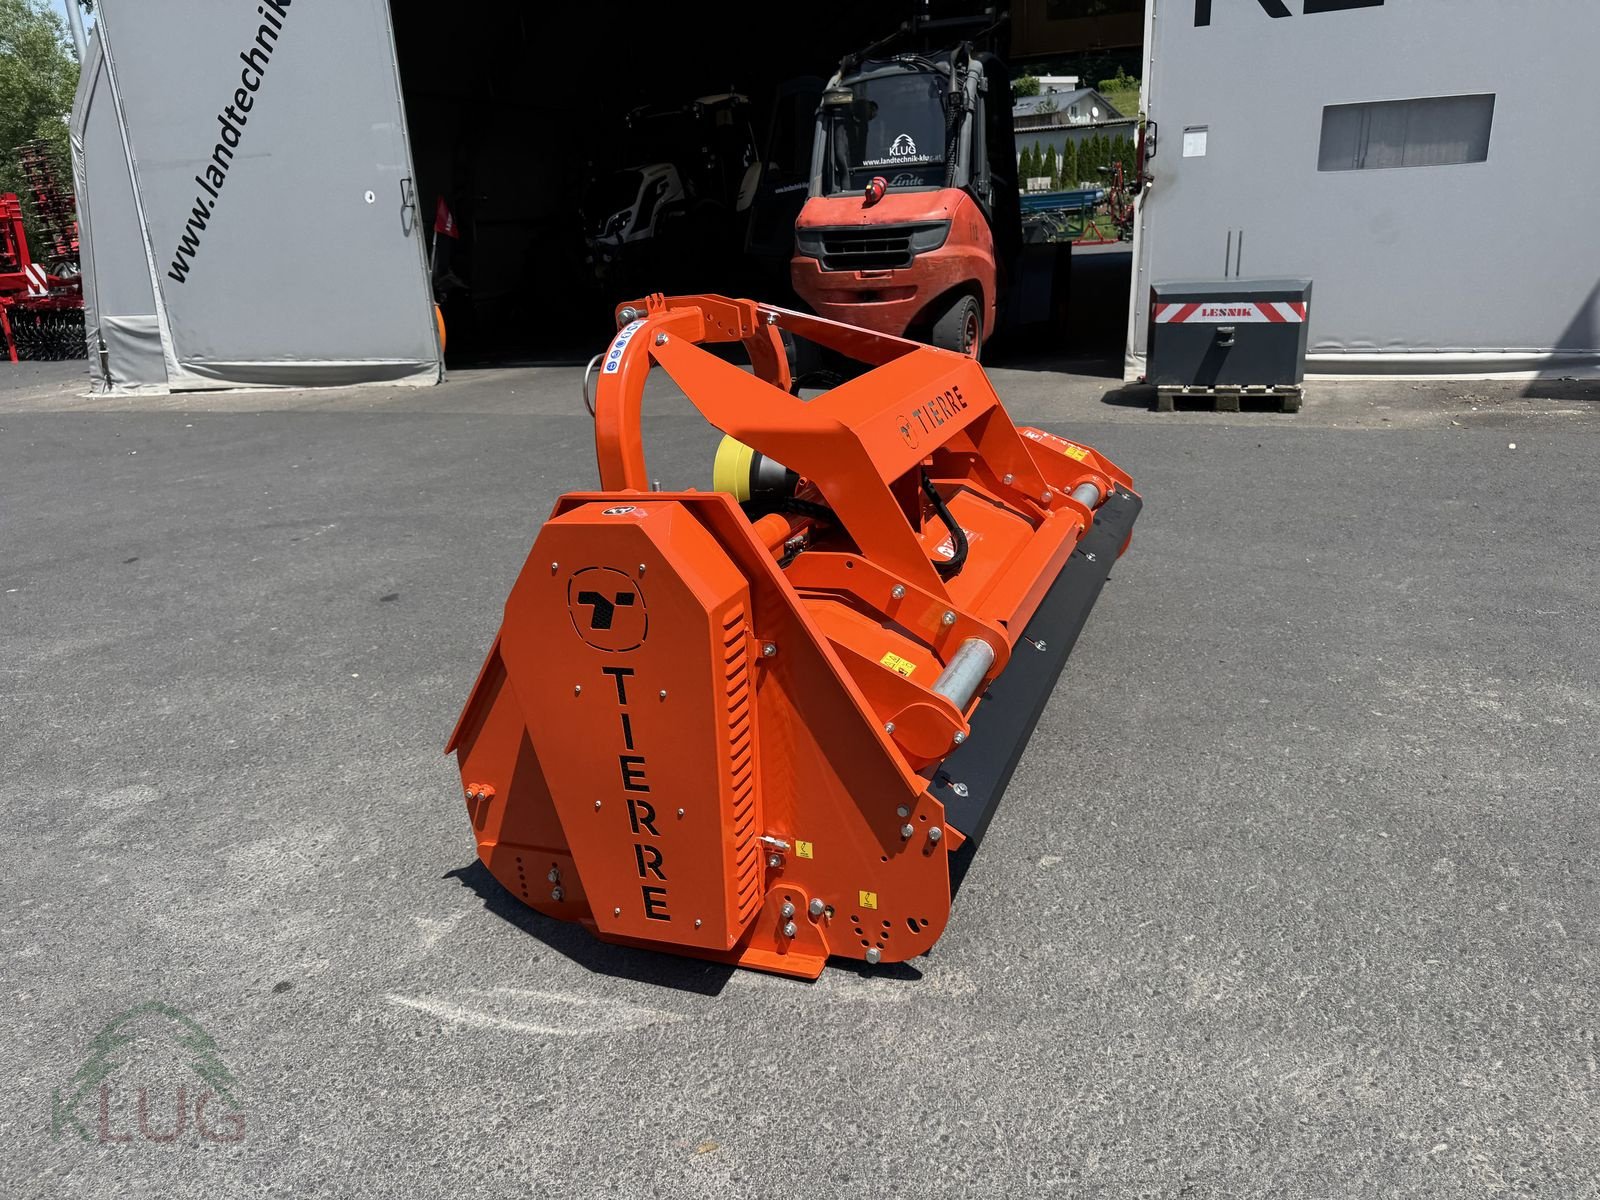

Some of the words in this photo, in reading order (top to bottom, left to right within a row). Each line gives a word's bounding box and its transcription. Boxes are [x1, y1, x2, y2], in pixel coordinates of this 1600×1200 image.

[889, 145, 917, 156] KLUG
[889, 173, 925, 186] Linde
[1202, 308, 1253, 317] LESNIK
[912, 386, 968, 434] TIERRE
[602, 665, 671, 922] TIERRE
